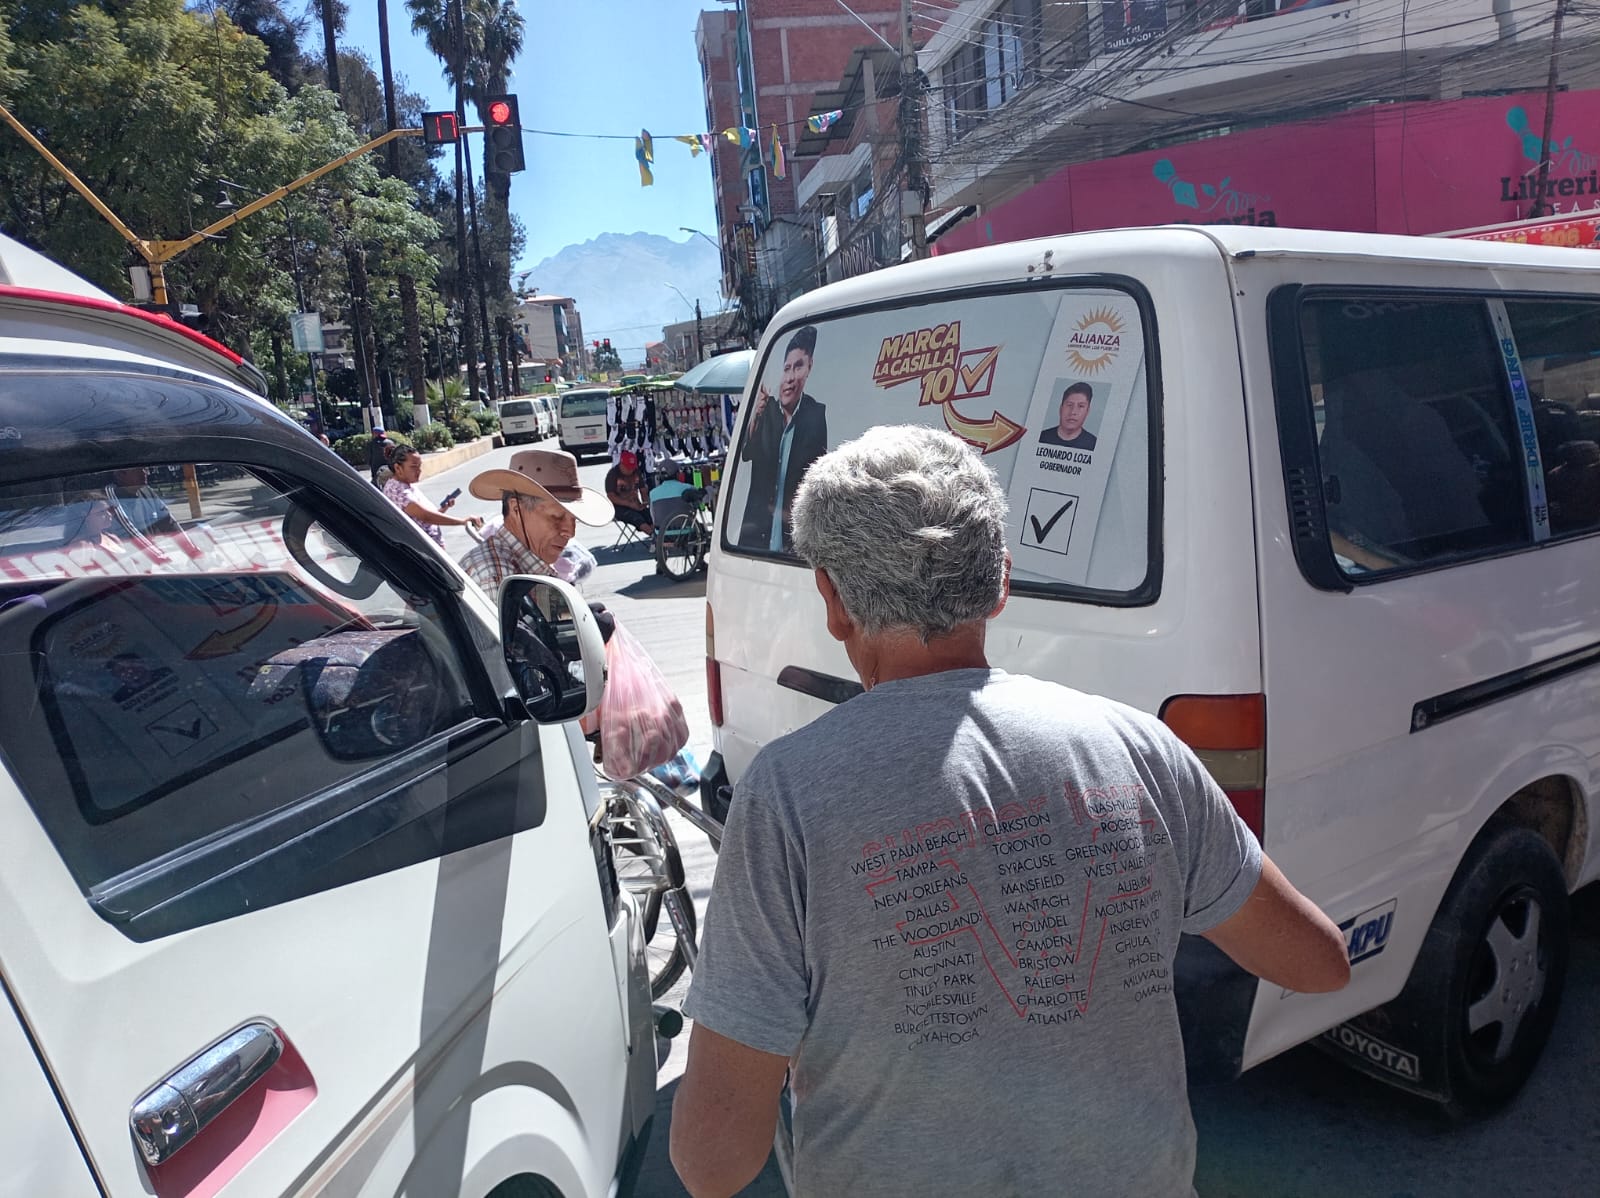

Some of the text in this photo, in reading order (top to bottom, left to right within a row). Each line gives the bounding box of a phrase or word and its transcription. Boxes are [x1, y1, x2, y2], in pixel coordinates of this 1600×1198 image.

[436, 114, 458, 140] 17
[1501, 170, 1600, 202] Libreri
[878, 321, 961, 363] MARCA
[1070, 332, 1120, 347] ALIANZA
[874, 348, 956, 377] LA CASILLA
[920, 367, 955, 405] 10
[1036, 447, 1092, 465] LEONARDO LOZA
[1040, 460, 1082, 476] GOBERNADOR
[1089, 798, 1138, 814] NASHVILLE
[984, 812, 1051, 836] CLARKSTON
[851, 829, 967, 875] WEST PALM BEACH
[992, 834, 1051, 856] TORONTO
[1065, 837, 1140, 861] GREENWOOD
[895, 861, 939, 882] TAMPA
[998, 854, 1056, 876] SYRACUSE
[1083, 862, 1118, 878] WEST
[1119, 856, 1146, 873] VALLEY
[873, 873, 968, 911] NEW ORLEANS
[1001, 874, 1065, 897] MANSFIELD
[906, 901, 950, 923] DALLAS
[1003, 895, 1070, 915] WANTAGH
[872, 911, 982, 951] THE WOODLANDS
[1012, 915, 1069, 932] HOLMDEL
[913, 937, 956, 960] AUSTIN
[1015, 934, 1072, 952] CAMDEN
[1115, 935, 1151, 953] CHULA
[898, 953, 974, 980] CINCINNATI
[1019, 954, 1075, 971] BRISTOW
[1128, 952, 1164, 969] PHOEN
[903, 974, 976, 998] TINLEY PARK
[1024, 973, 1075, 989] RALEIGH
[1016, 989, 1087, 1007] CHARLOTTE
[894, 1004, 988, 1034] BURGETTSTOWN
[1027, 1009, 1082, 1025] ATLANTA
